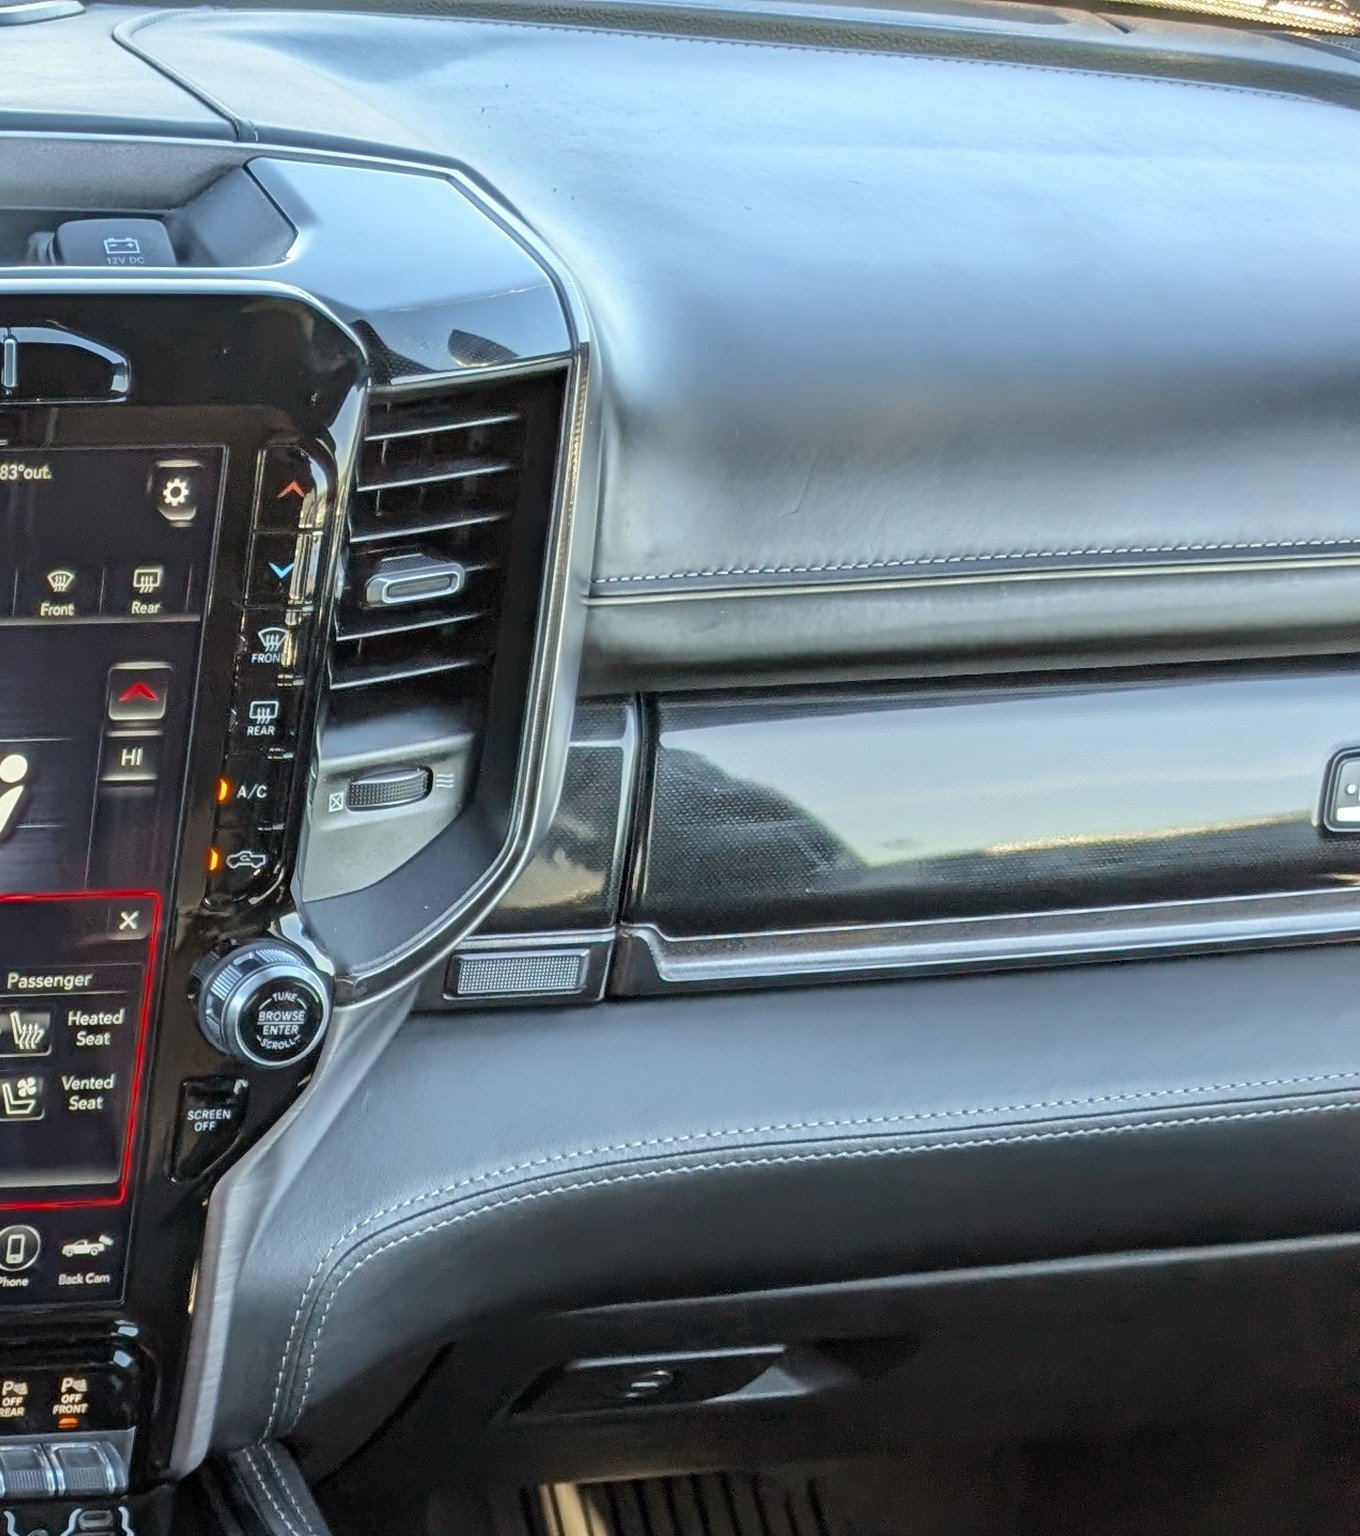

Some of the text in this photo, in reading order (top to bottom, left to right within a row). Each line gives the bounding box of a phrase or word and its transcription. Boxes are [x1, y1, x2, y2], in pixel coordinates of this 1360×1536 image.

[106, 256, 145, 265] 12V DC
[0, 464, 52, 480] 83°out.
[40, 602, 73, 616] Front
[131, 601, 160, 614] Rear
[246, 725, 275, 736] REAR
[120, 746, 143, 766] HI
[236, 783, 267, 798] A/C
[6, 972, 93, 990] Passenger
[271, 991, 298, 1003] TUNE
[67, 1008, 125, 1025] Heated
[258, 1010, 305, 1022] BROWSE
[262, 1025, 299, 1036] ENTER
[76, 1031, 111, 1046] Seat
[260, 1037, 296, 1050] SCROLL
[61, 1073, 116, 1090] Vented
[69, 1096, 104, 1111] Seat
[186, 1109, 230, 1121] SCREEN
[194, 1121, 216, 1133] OFF
[58, 1272, 110, 1285] Back Cam
[1, 1397, 23, 1407] OFF
[60, 1393, 82, 1404] OFF
[52, 1403, 88, 1415] FRONT
